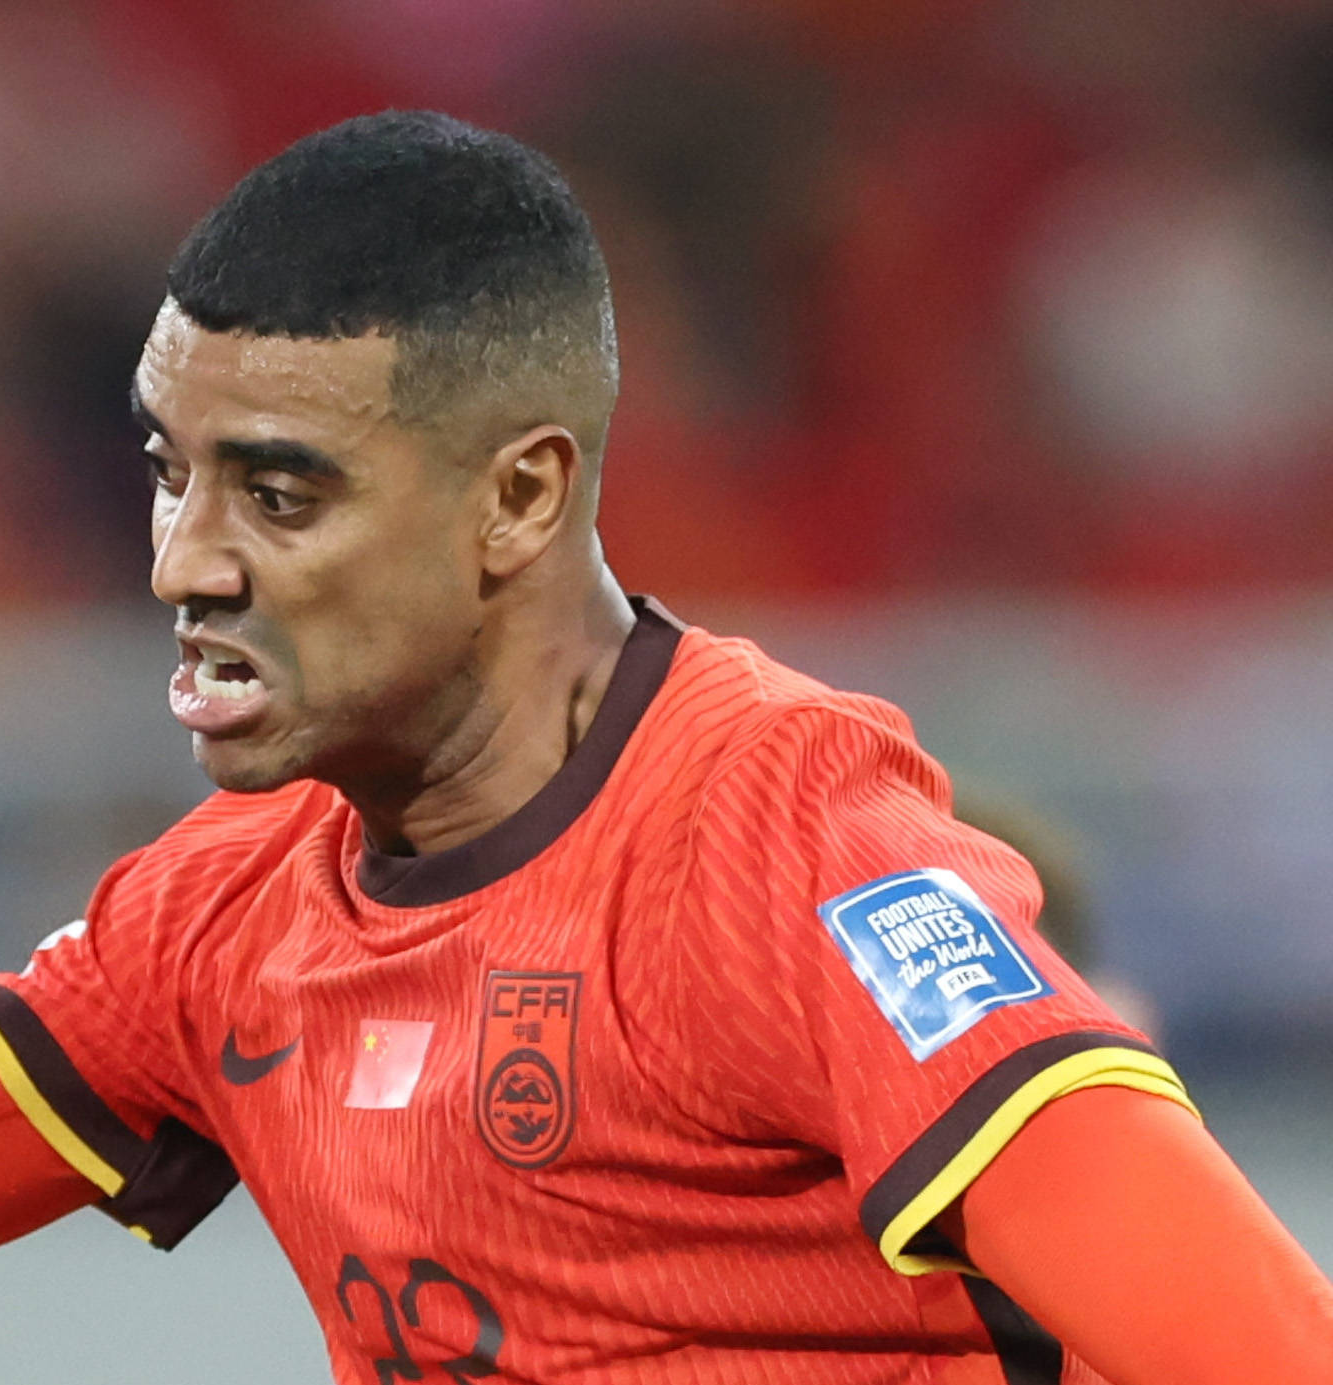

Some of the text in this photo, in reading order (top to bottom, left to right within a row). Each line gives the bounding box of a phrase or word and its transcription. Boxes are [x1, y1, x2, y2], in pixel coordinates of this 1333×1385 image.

[866, 889, 958, 936] FOOTBALL
[880, 908, 976, 961] UNITES
[897, 932, 996, 989] the World
[947, 970, 983, 991] FIFA
[492, 985, 570, 1019] CFA
